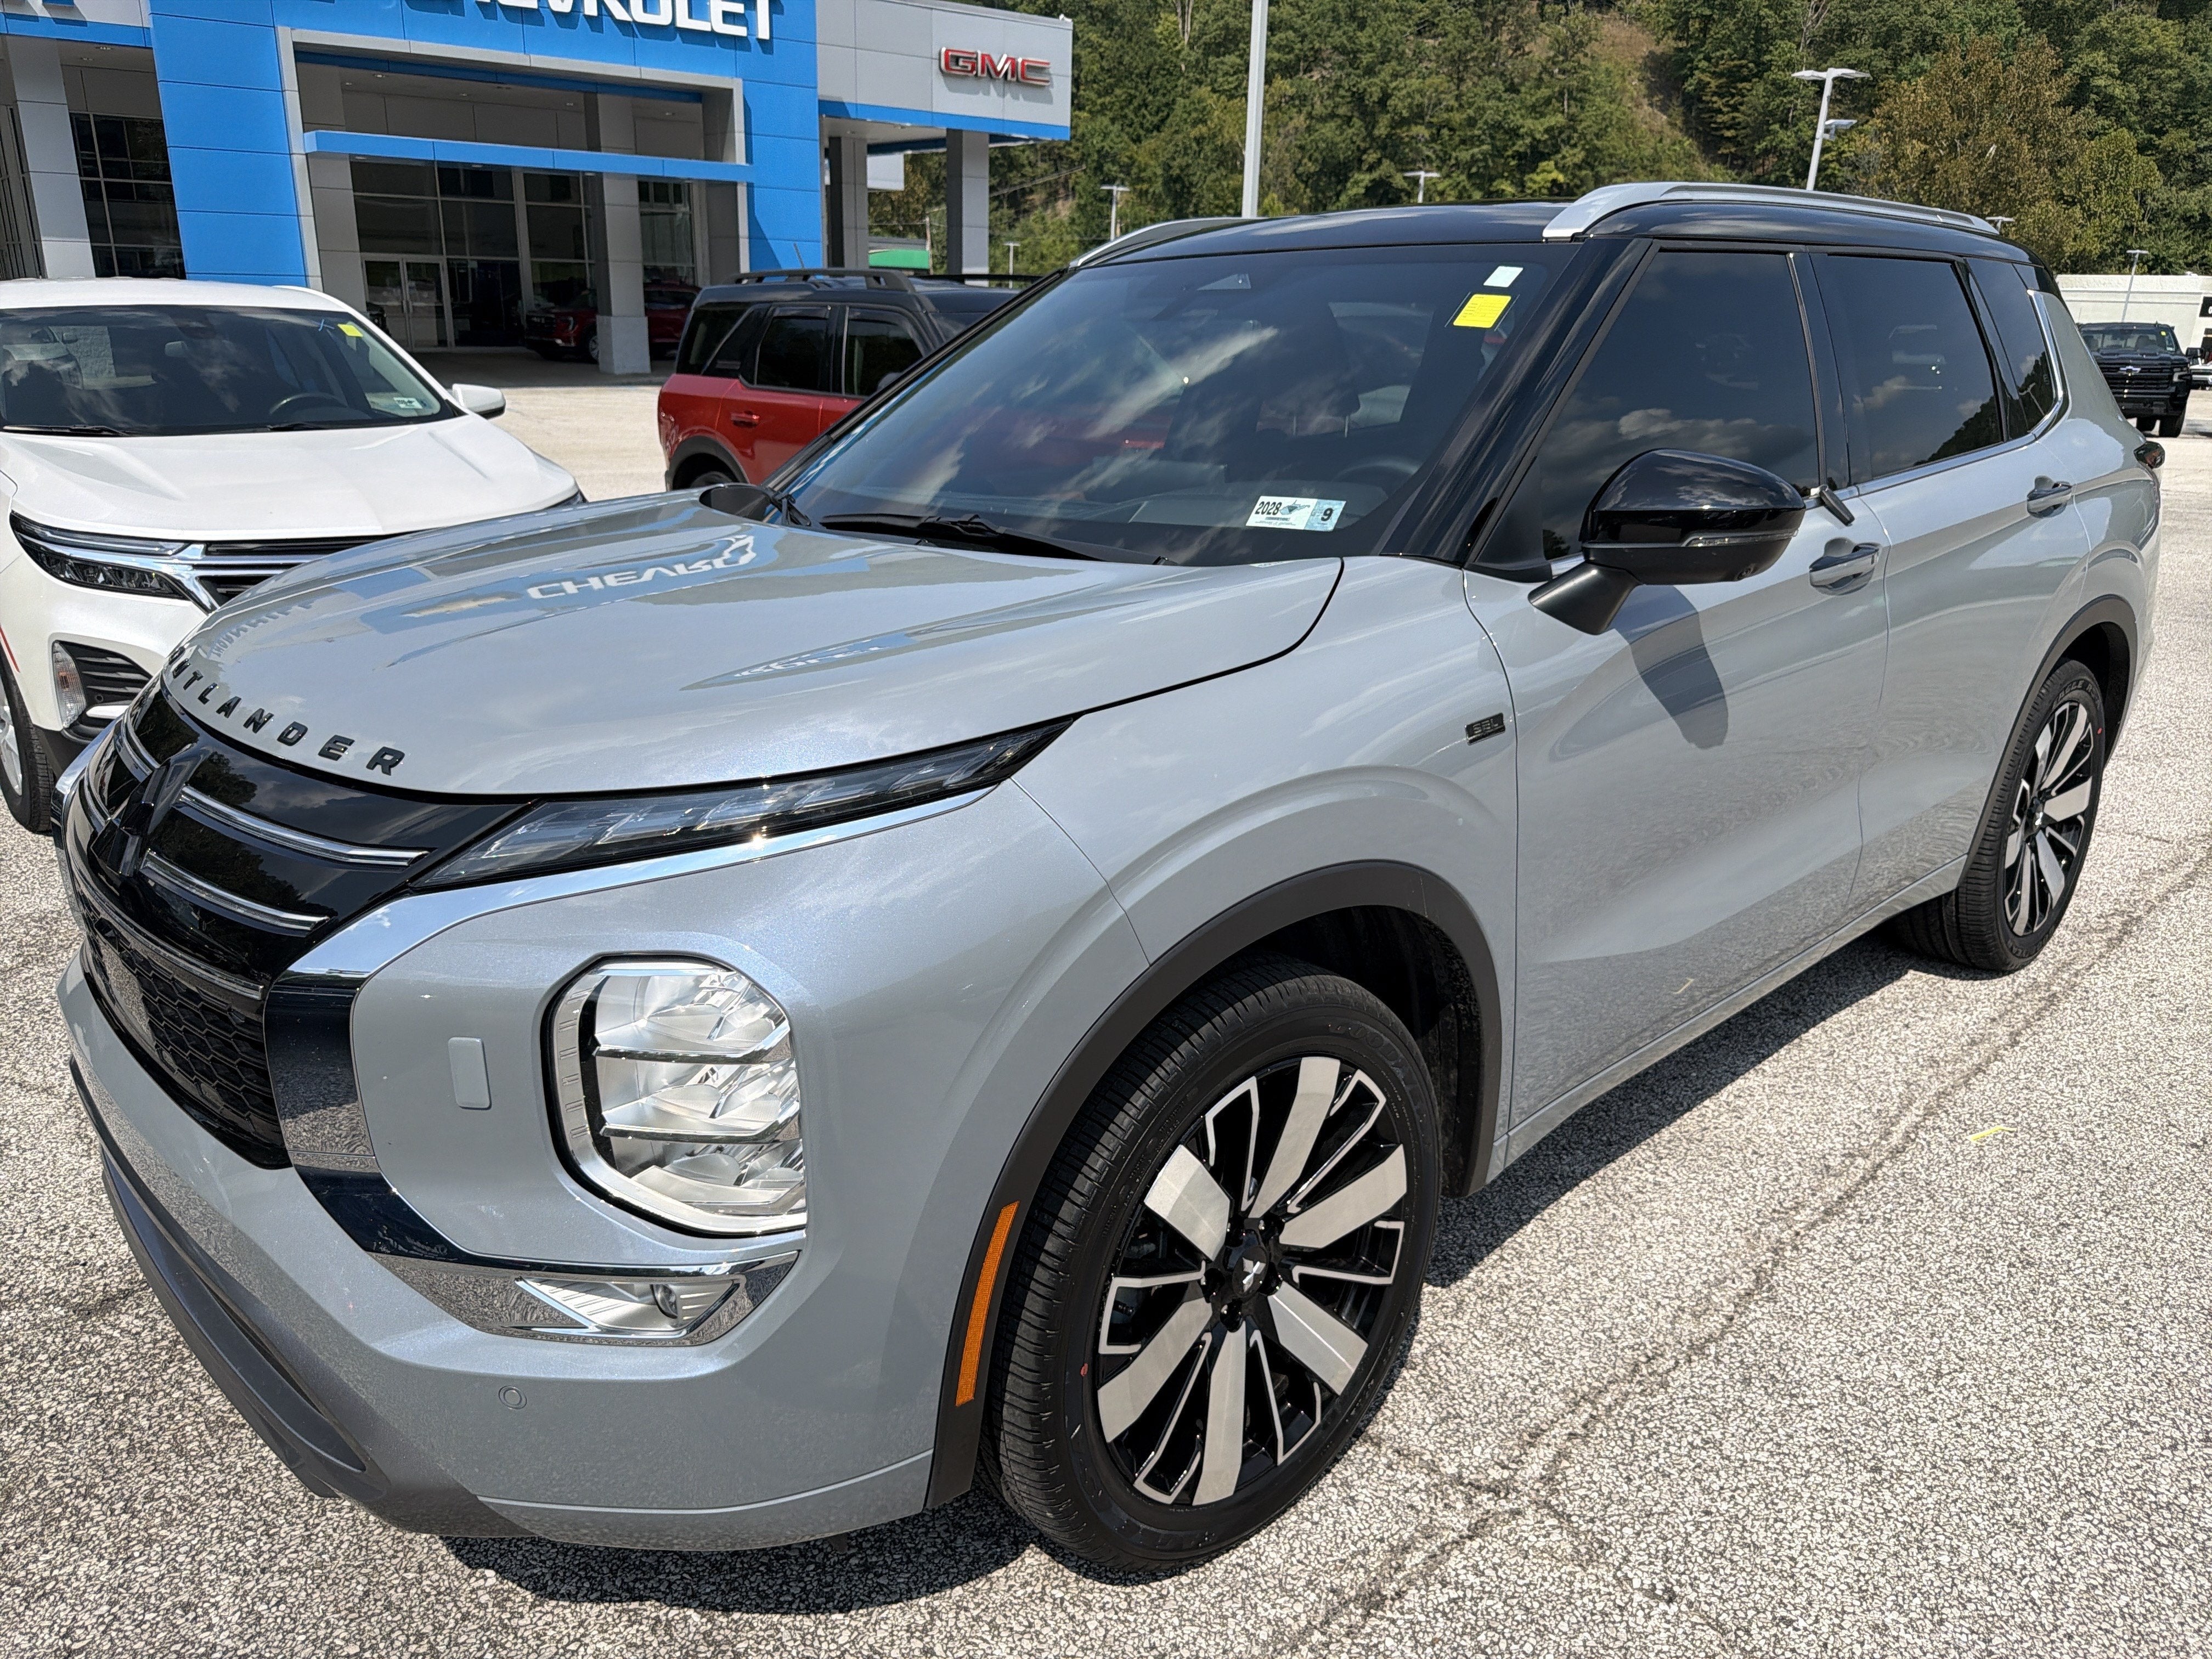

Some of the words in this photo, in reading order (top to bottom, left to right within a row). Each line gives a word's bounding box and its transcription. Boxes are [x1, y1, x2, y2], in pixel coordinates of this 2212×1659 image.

[939, 47, 1051, 86] GMC
[1255, 501, 1282, 516] 2028
[1321, 507, 1334, 522] 9
[168, 646, 405, 776] OUTLANDER
[1472, 718, 1498, 735] SEL
